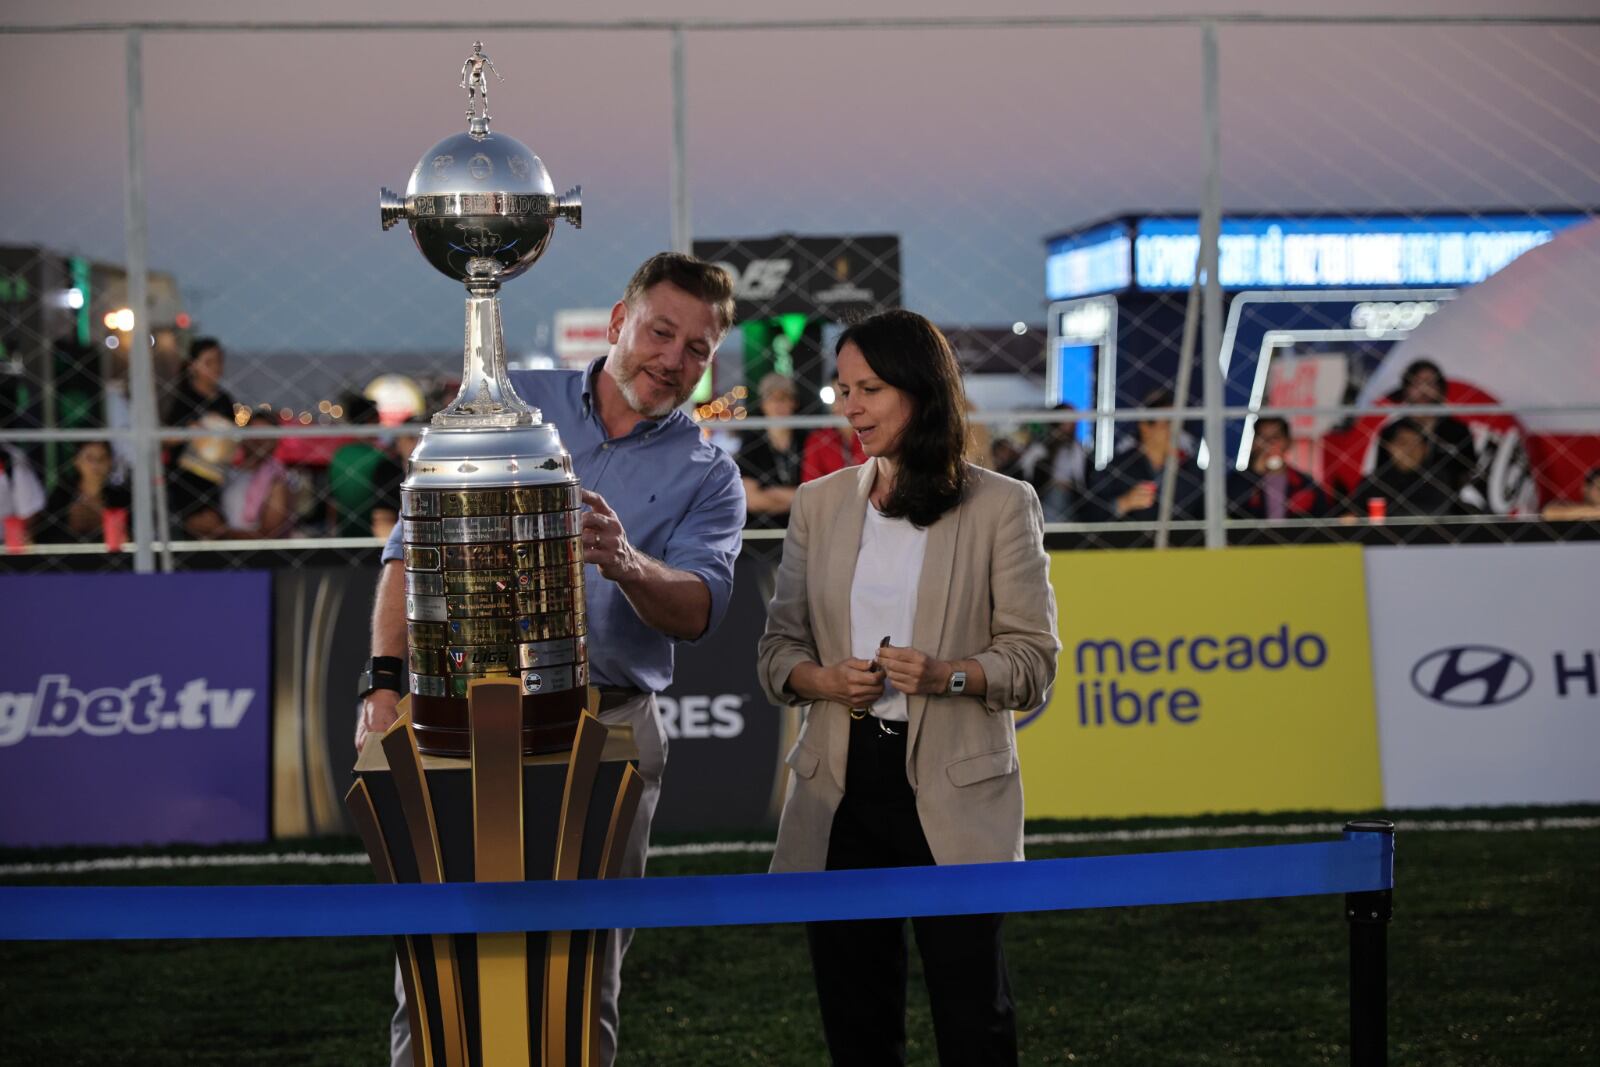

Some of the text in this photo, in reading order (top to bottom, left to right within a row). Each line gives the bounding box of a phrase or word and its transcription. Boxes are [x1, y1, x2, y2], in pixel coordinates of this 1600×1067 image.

[1076, 624, 1328, 674] mercado
[1552, 651, 1600, 696] H
[1077, 681, 1202, 728] libre
